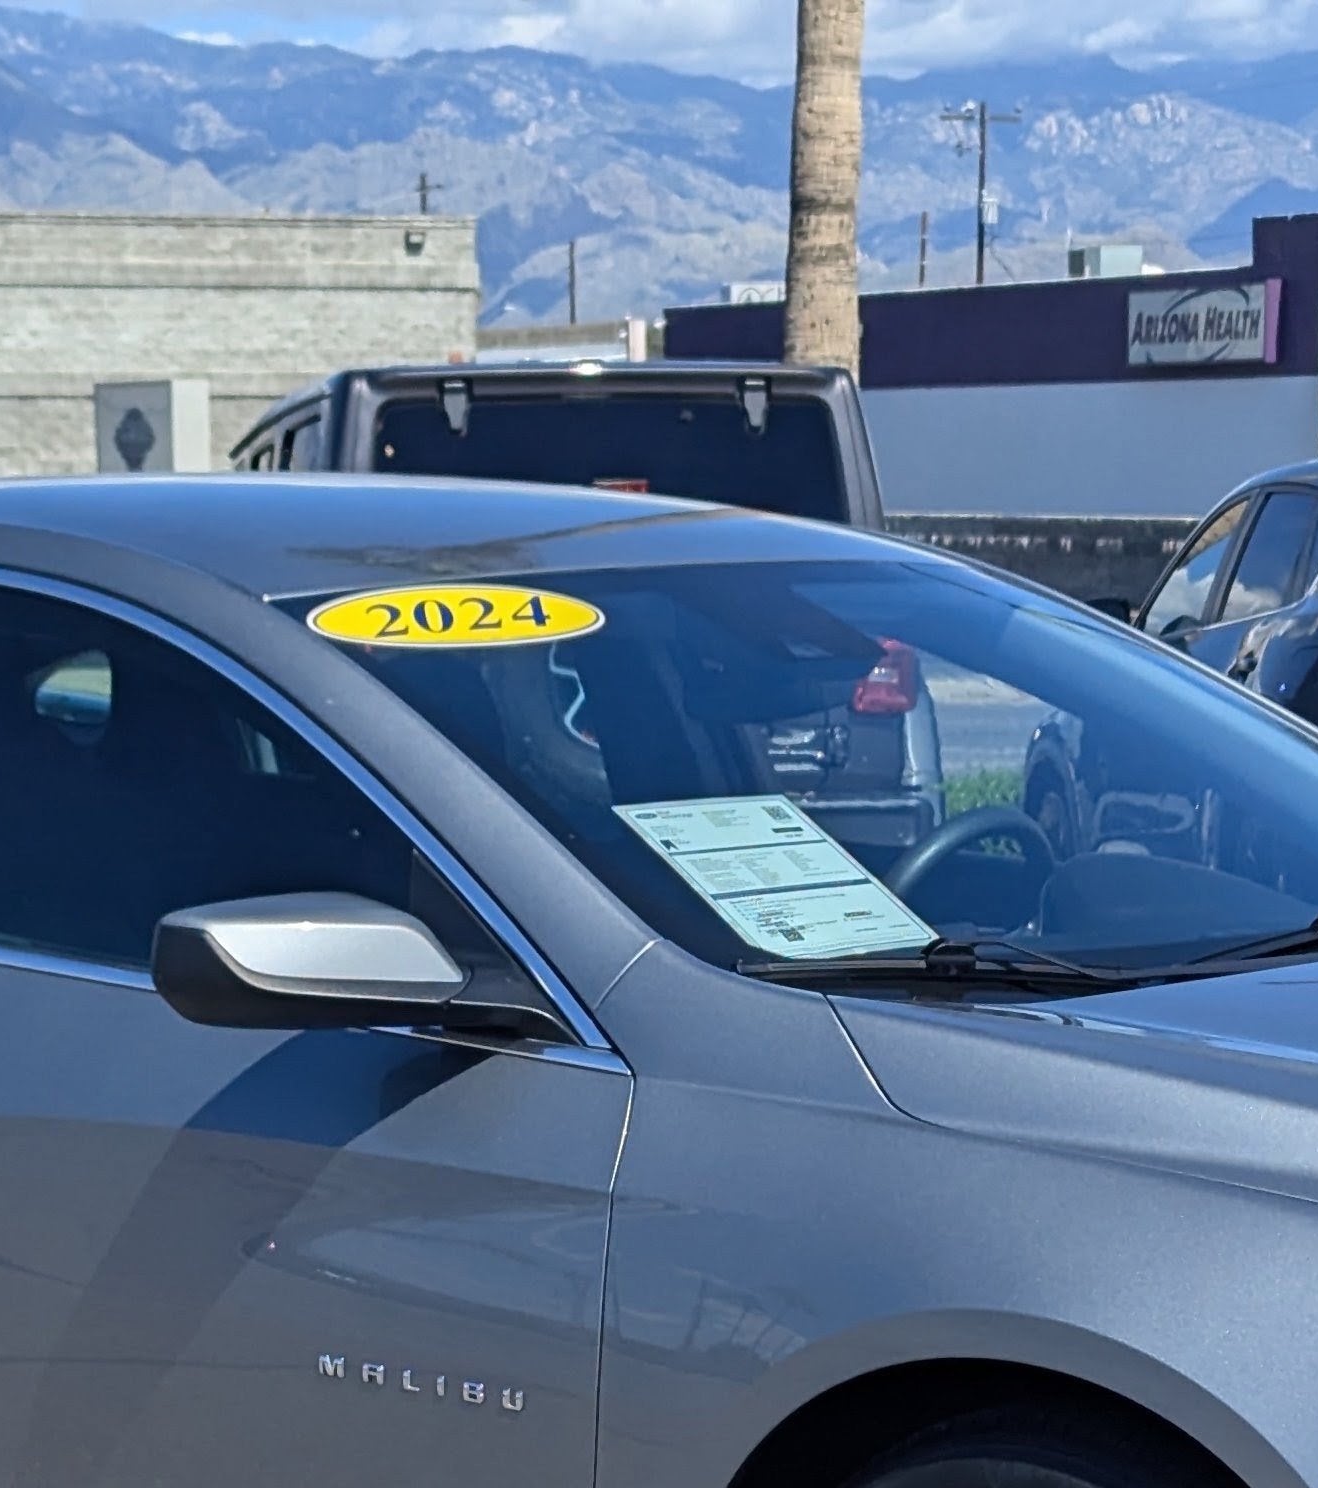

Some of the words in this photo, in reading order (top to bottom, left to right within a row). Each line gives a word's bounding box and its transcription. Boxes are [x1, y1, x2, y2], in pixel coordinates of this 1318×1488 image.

[1131, 311, 1199, 346] ARIZONA
[1203, 305, 1261, 342] HEALTH
[365, 596, 551, 638] 2024
[318, 1354, 524, 1411] MALIBU
